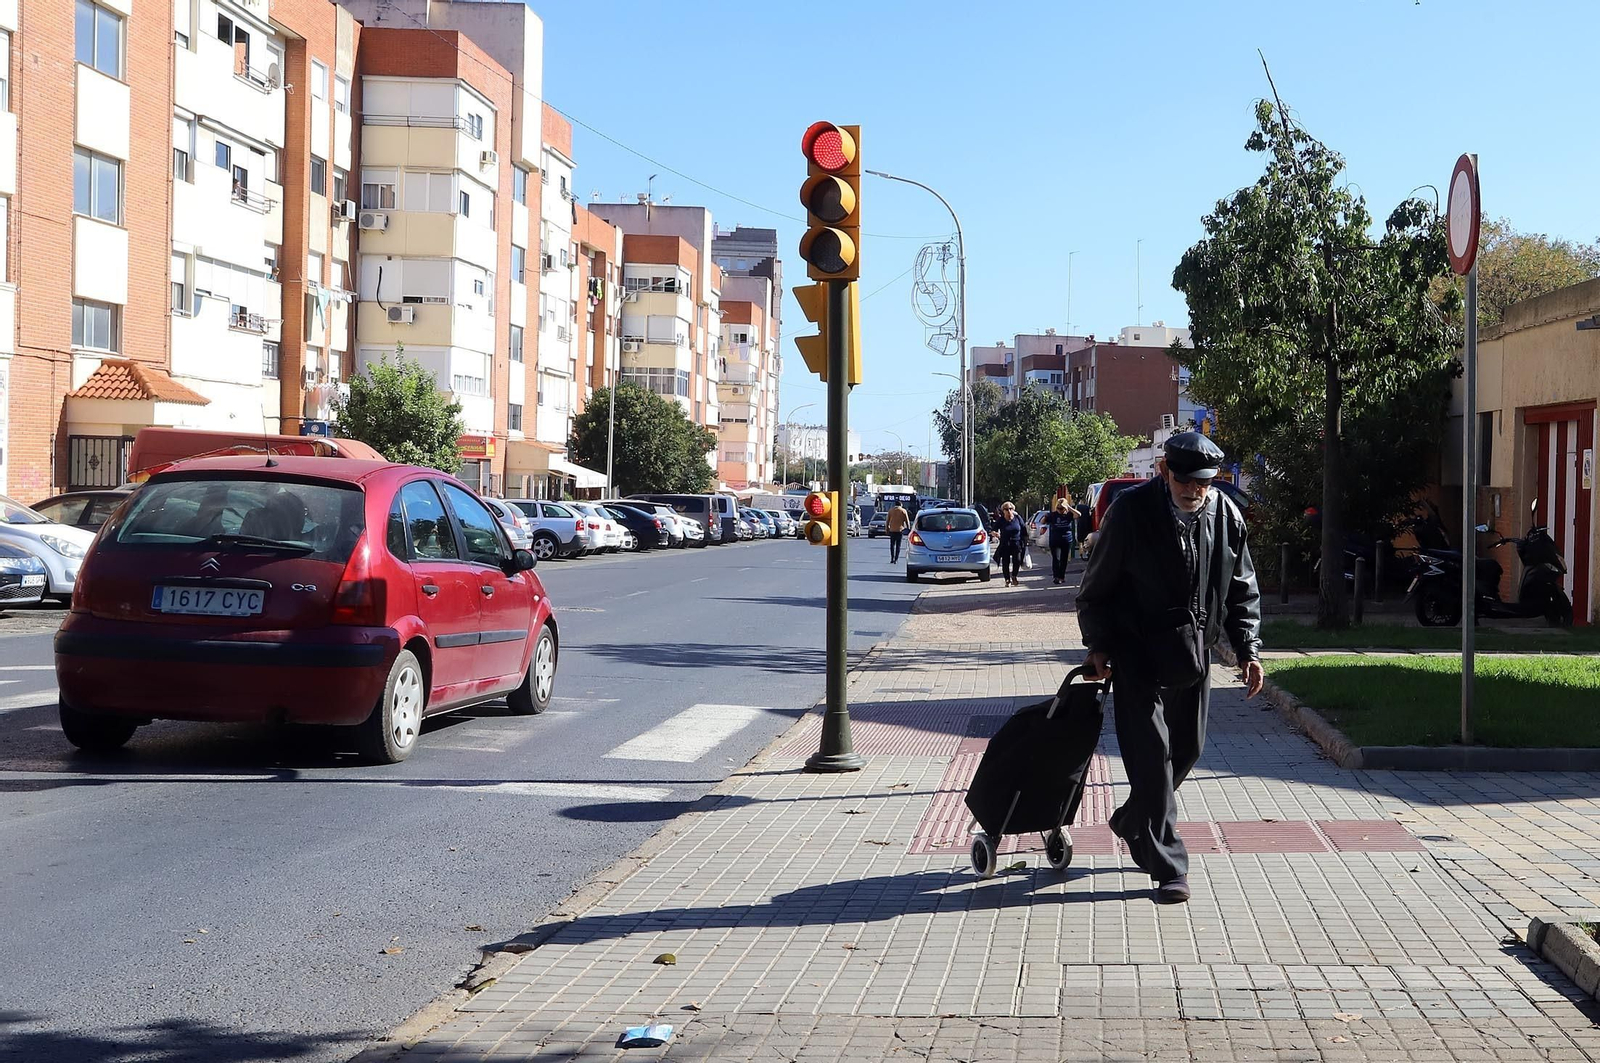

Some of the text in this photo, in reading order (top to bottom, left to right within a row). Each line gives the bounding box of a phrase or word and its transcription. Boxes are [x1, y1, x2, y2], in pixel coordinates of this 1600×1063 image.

[290, 582, 318, 592] C3
[169, 589, 216, 608] 1617
[222, 591, 259, 610] CYC
